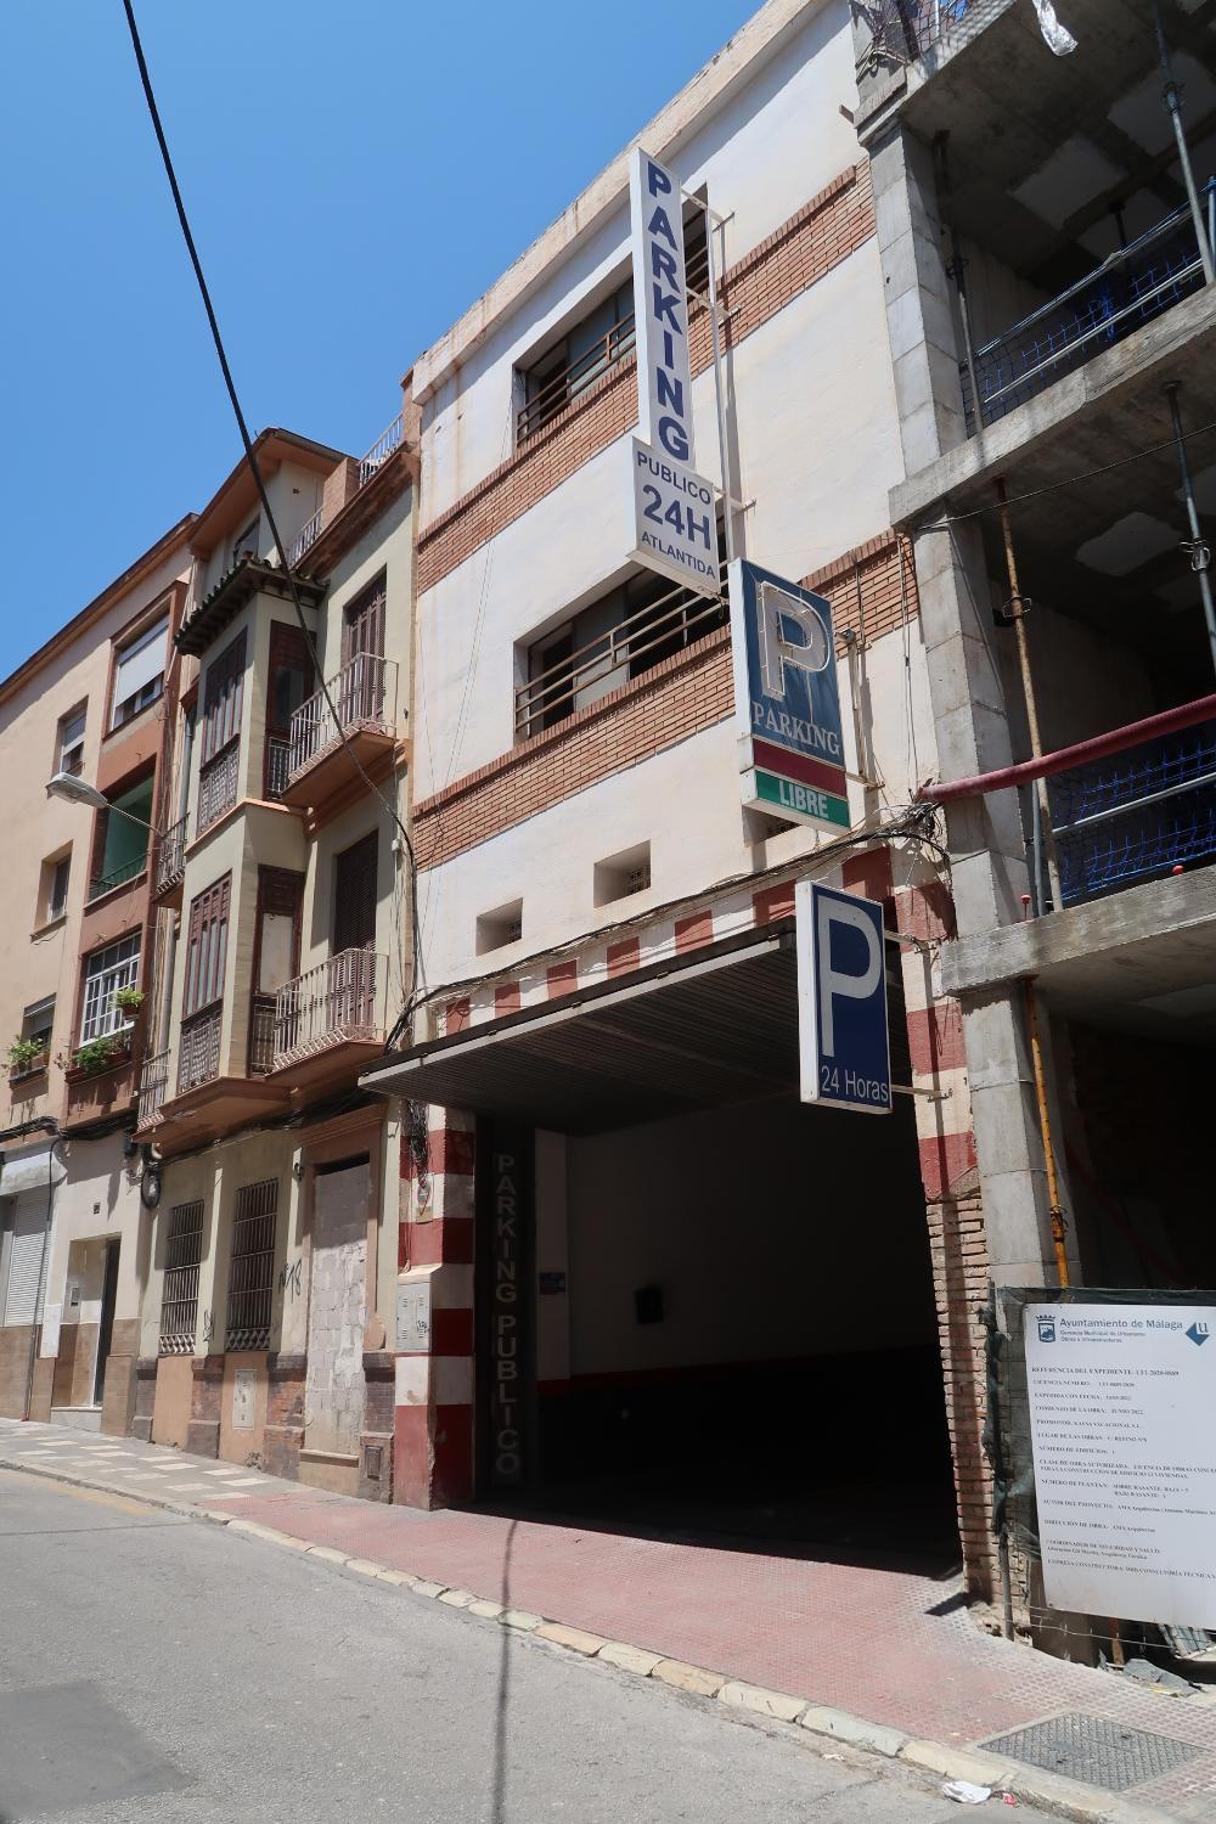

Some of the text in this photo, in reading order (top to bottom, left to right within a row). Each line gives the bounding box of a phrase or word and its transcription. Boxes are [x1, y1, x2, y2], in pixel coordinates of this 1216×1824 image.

[647, 160, 689, 462] PARKING
[637, 450, 712, 506] PUBLICO
[642, 484, 712, 550] 24H
[641, 530, 716, 579] ATLANTIDA
[757, 580, 831, 700] P
[751, 701, 841, 756] PARKING
[778, 779, 829, 819] LIBRE
[817, 894, 884, 1058] P
[821, 1065, 889, 1102] 24 Horas
[495, 1153, 520, 1475] PARKING PUBLICO
[1060, 1318, 1128, 1329] Ayuntamiento
[1131, 1319, 1144, 1328] de
